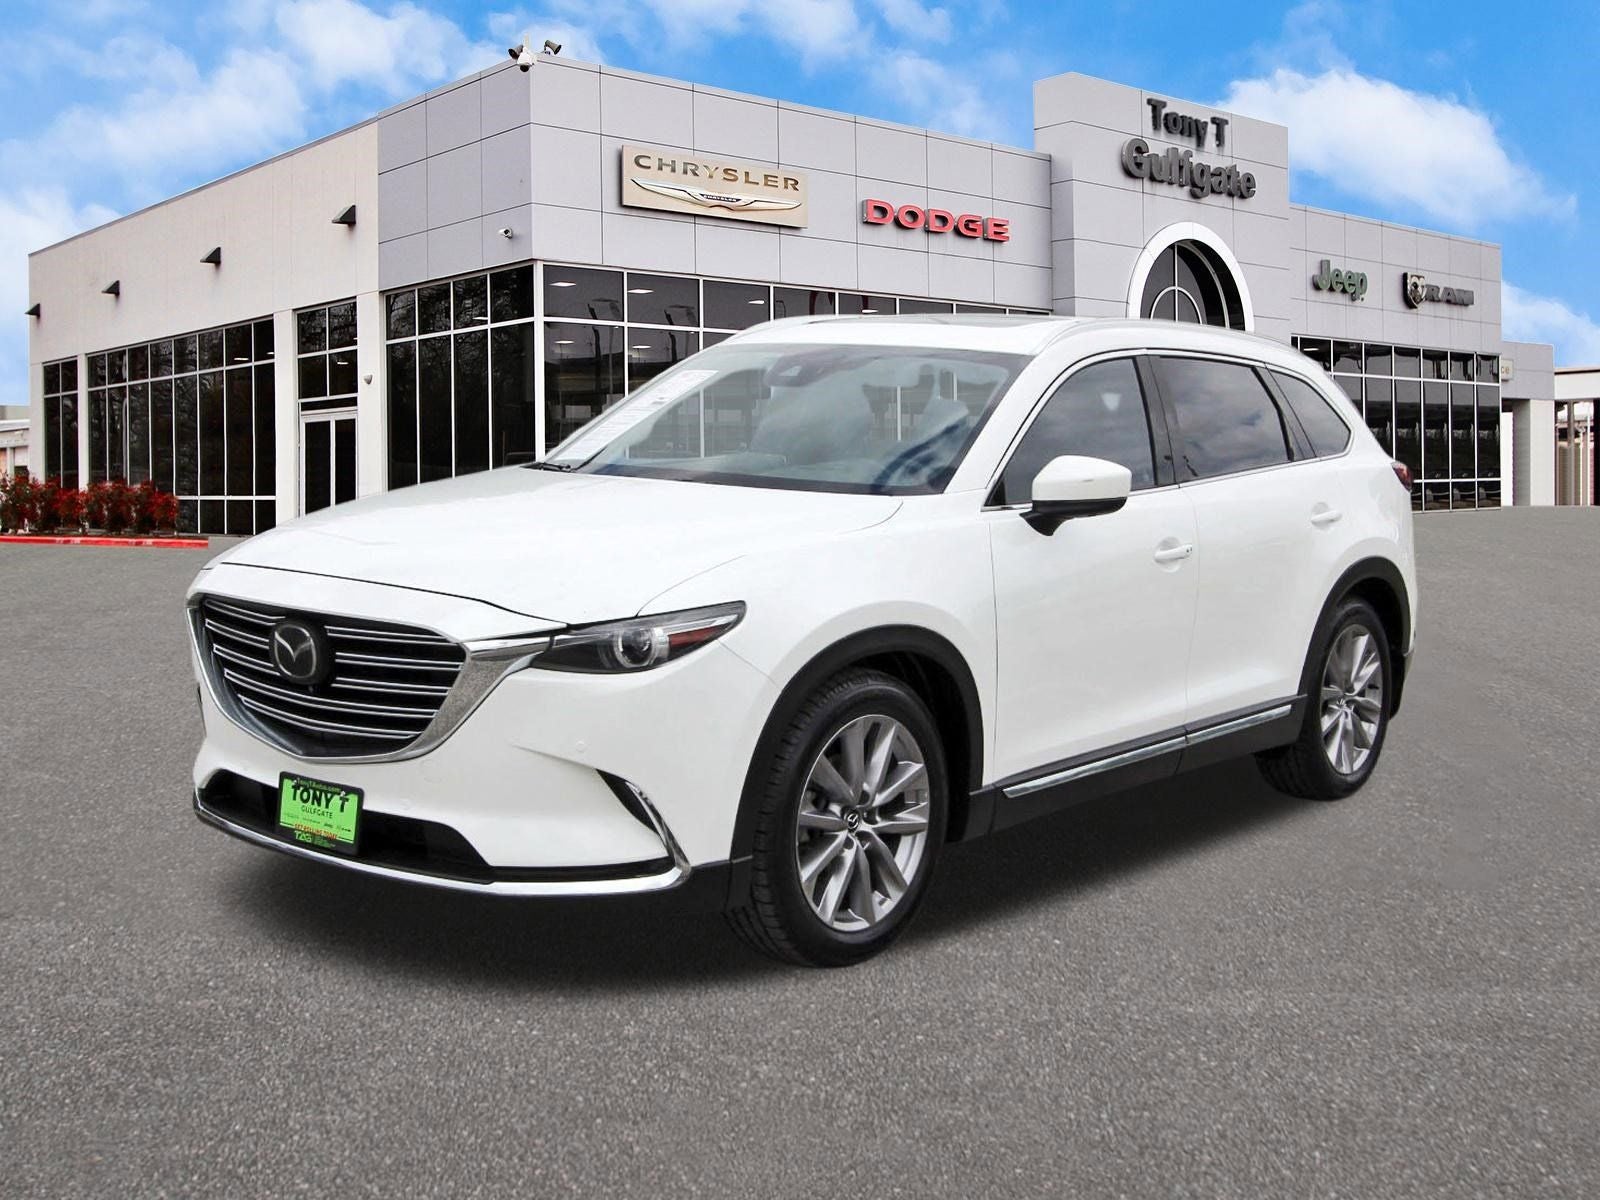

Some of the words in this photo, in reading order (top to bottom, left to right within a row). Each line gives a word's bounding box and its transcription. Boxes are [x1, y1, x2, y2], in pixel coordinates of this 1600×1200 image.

[1147, 98, 1208, 148] Tony
[1210, 116, 1229, 147] T
[633, 154, 800, 191] CHRYSLER
[1121, 138, 1257, 199] Gulfgate
[862, 198, 1010, 242] DODGE
[1312, 259, 1368, 301] Jeep
[1425, 283, 1474, 306] RAM
[292, 784, 334, 809] TONY
[339, 796, 350, 813] T
[301, 805, 333, 819] GULFGATE
